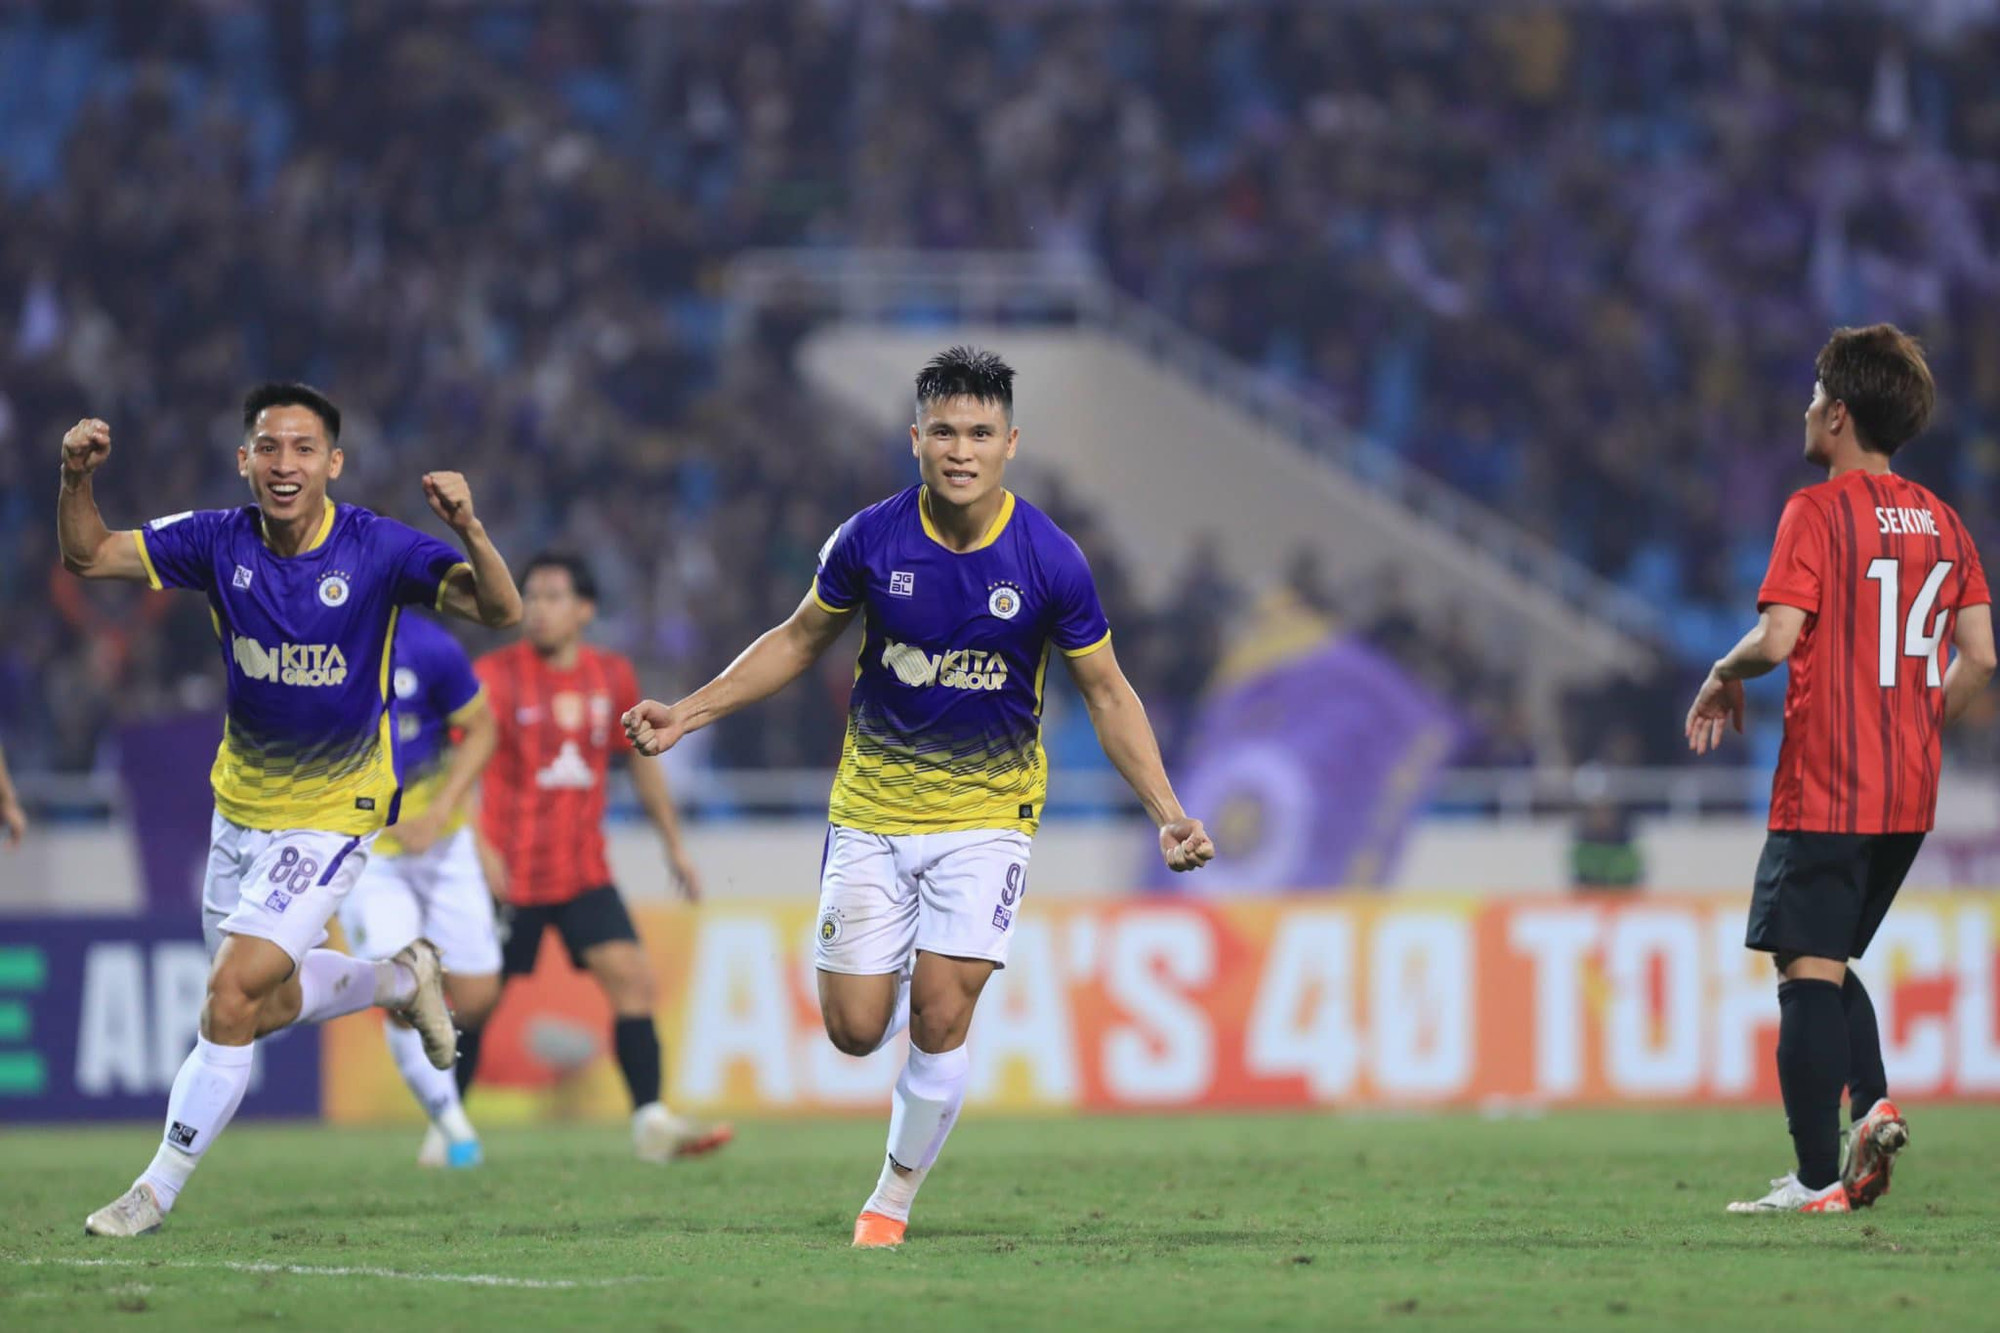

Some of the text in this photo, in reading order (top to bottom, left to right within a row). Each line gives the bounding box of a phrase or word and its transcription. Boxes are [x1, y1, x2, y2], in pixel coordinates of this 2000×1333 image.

[1875, 506, 1940, 536] SEKINE
[1865, 557, 1954, 688] 14
[281, 642, 347, 670] KITA
[940, 649, 1008, 673] KITA
[281, 667, 347, 687] GROUP
[939, 670, 1007, 690] GROUP
[268, 846, 318, 894] 88
[1001, 862, 1021, 906] 9
[677, 903, 1213, 1102] AA'S
[1243, 908, 1475, 1097] 40
